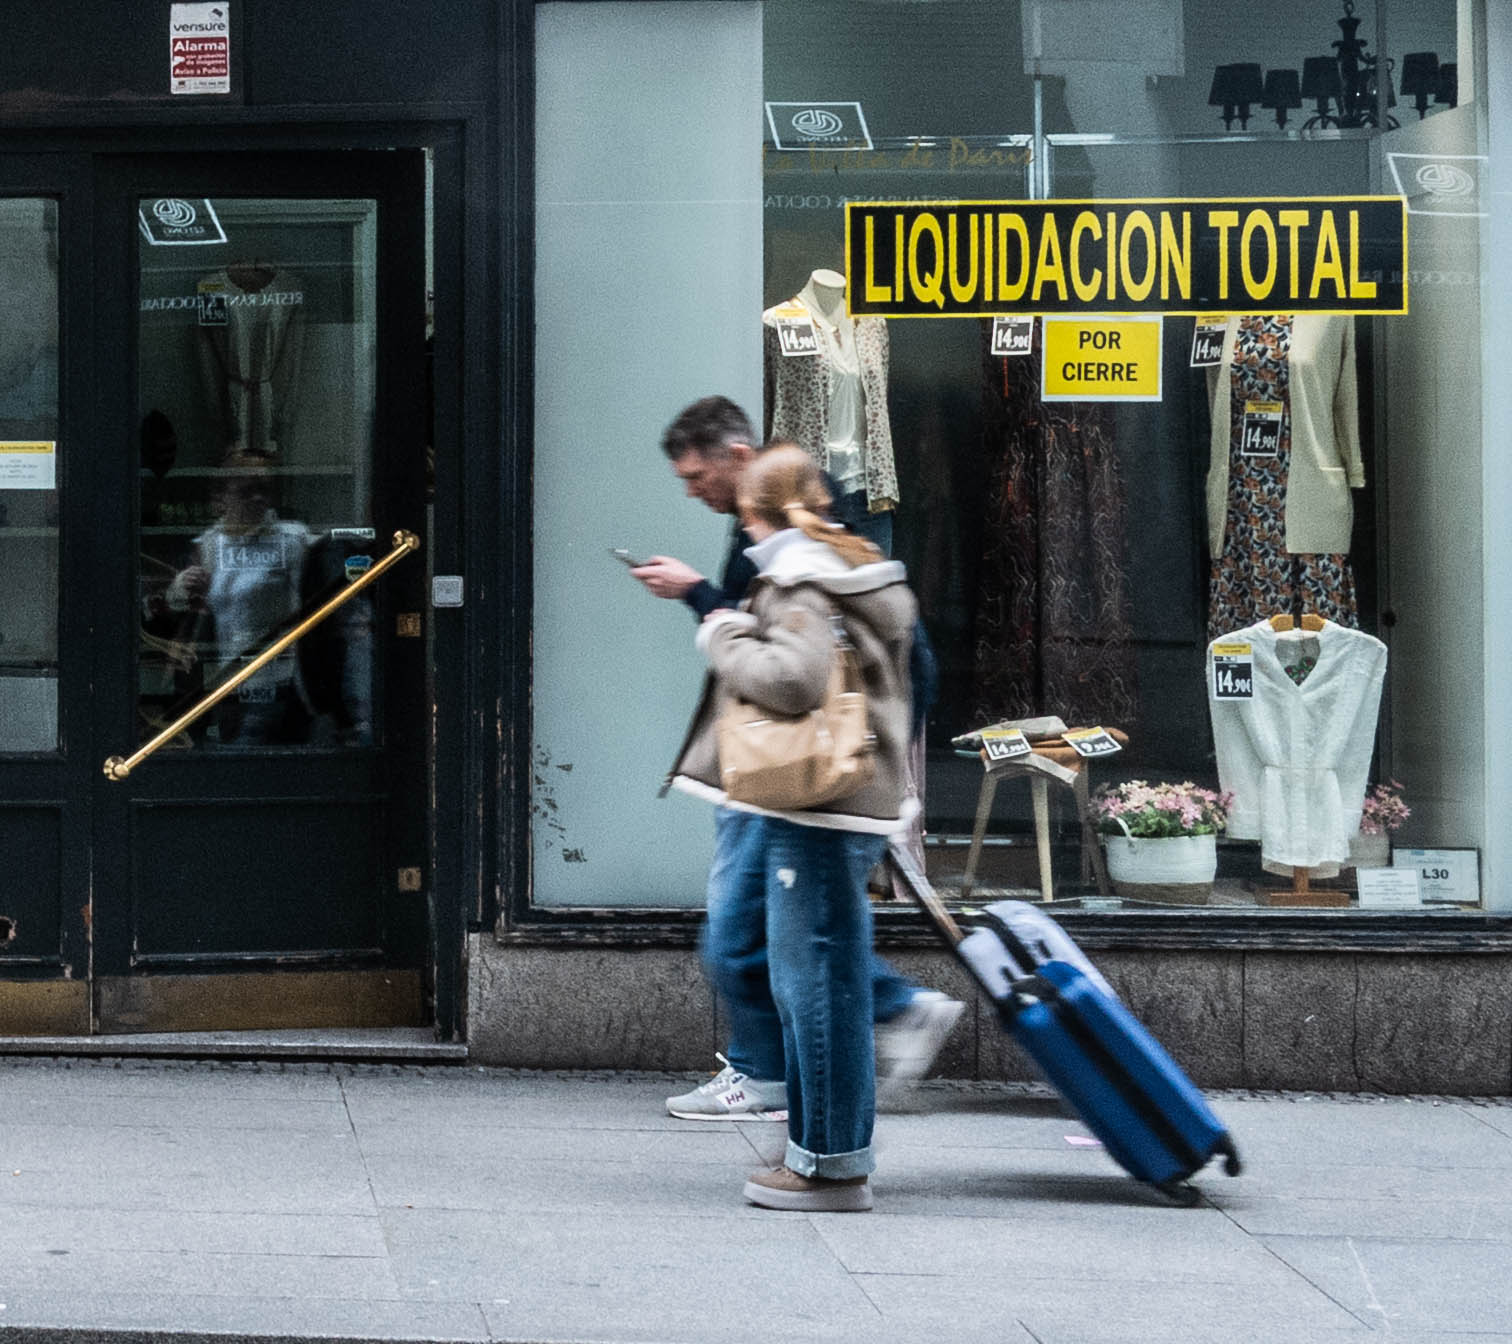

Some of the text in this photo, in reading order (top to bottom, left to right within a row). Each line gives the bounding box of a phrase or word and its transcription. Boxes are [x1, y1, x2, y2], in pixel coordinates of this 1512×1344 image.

[173, 22, 226, 32] verisure
[174, 40, 226, 52] Alarma
[864, 209, 1377, 309] LIQUIDACION TOTAL
[1079, 331, 1121, 350] POR
[1062, 362, 1138, 382] CIERRE
[1217, 669, 1252, 693] 14,90€
[1422, 868, 1450, 879] L30
[724, 1090, 746, 1105] HH
